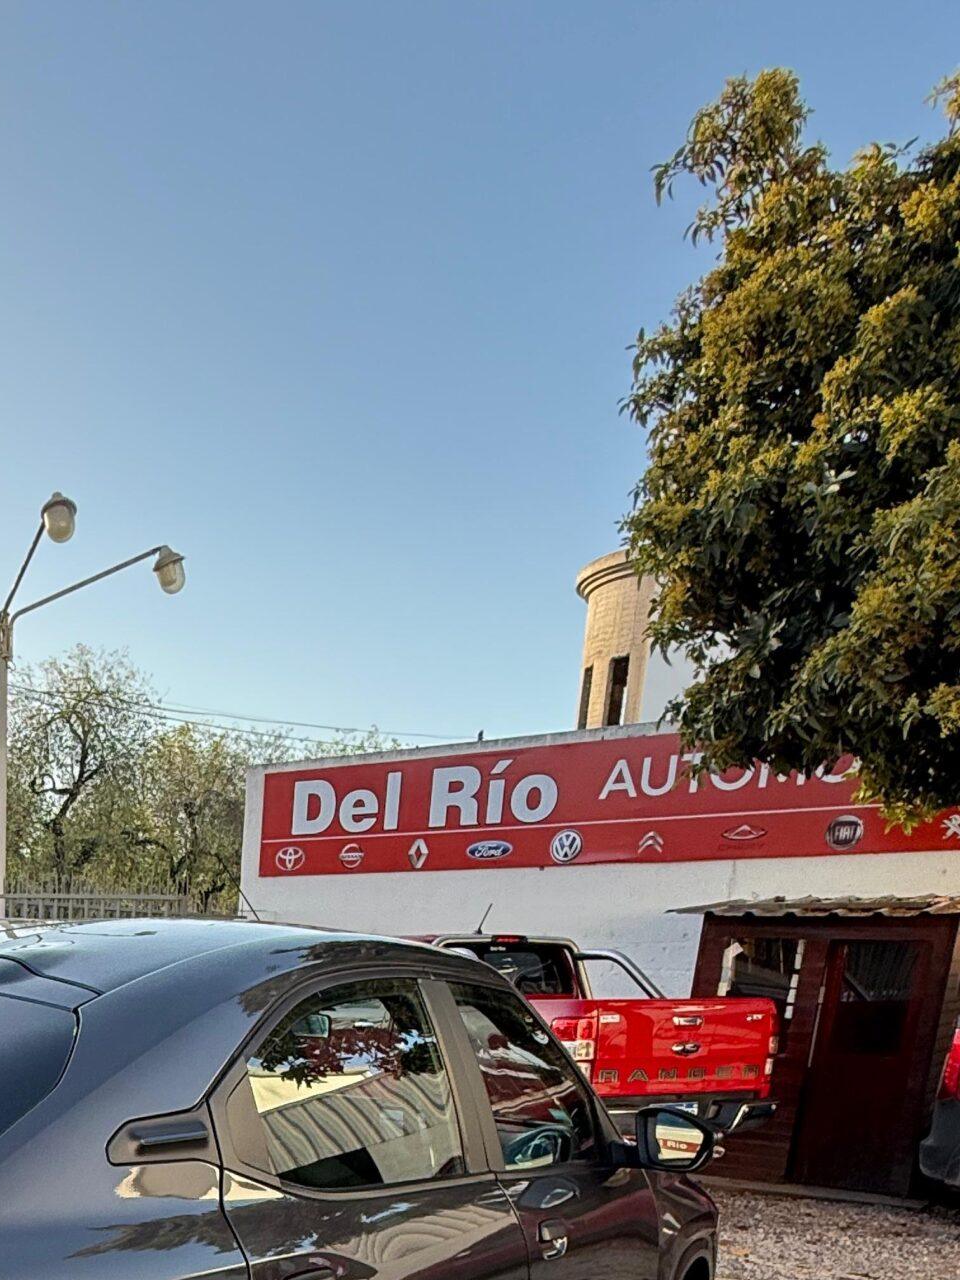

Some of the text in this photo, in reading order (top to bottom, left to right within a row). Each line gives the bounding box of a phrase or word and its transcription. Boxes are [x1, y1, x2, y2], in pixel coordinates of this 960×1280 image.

[291, 759, 559, 836] Del Río
[835, 825, 856, 841] FIAT
[474, 843, 504, 857] Ford
[598, 1065, 759, 1084] RANGER
